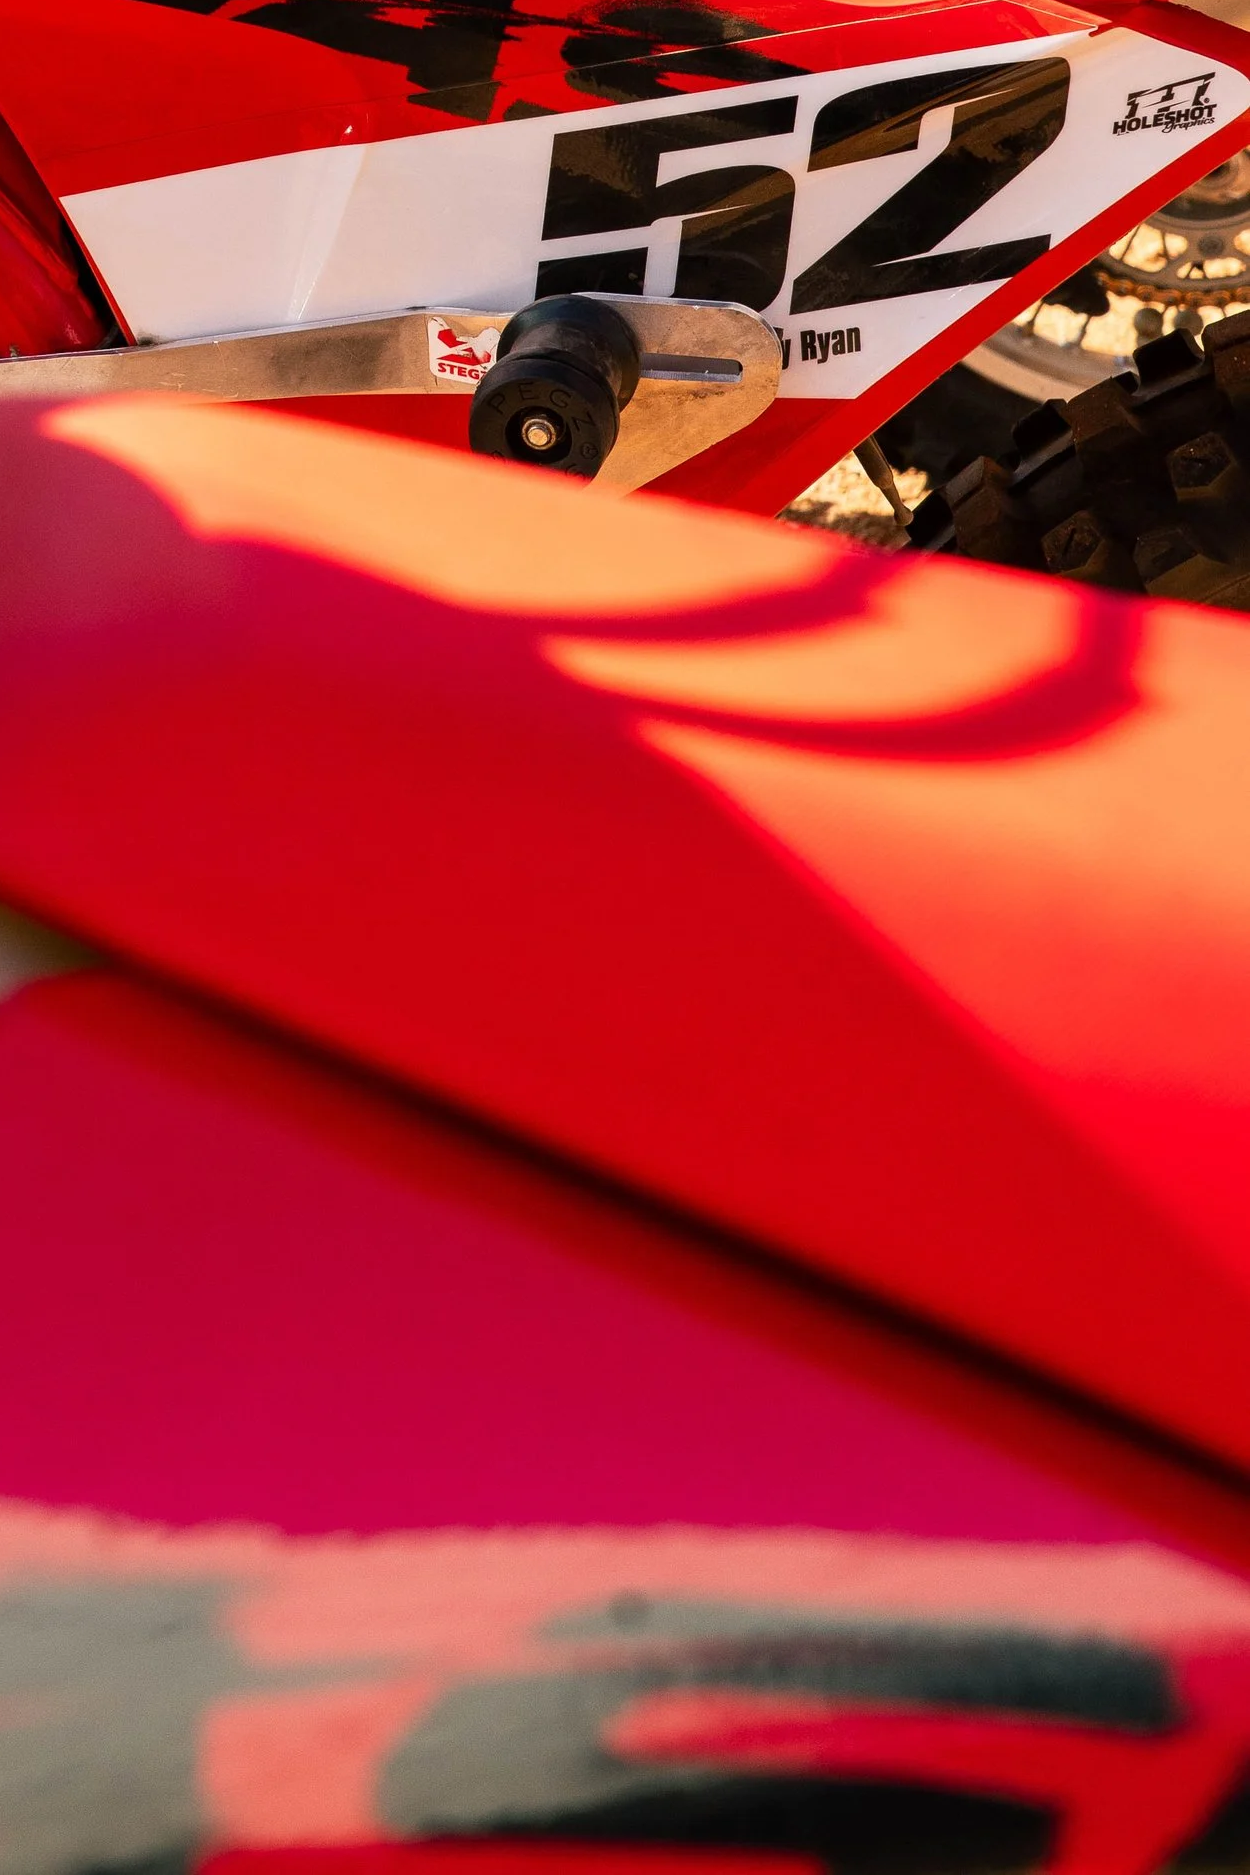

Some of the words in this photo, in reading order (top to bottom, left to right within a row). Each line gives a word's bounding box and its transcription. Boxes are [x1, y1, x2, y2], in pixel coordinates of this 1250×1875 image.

[1112, 103, 1218, 135] HOLESHOT
[535, 56, 1071, 316] 52
[800, 326, 862, 364] Ryan
